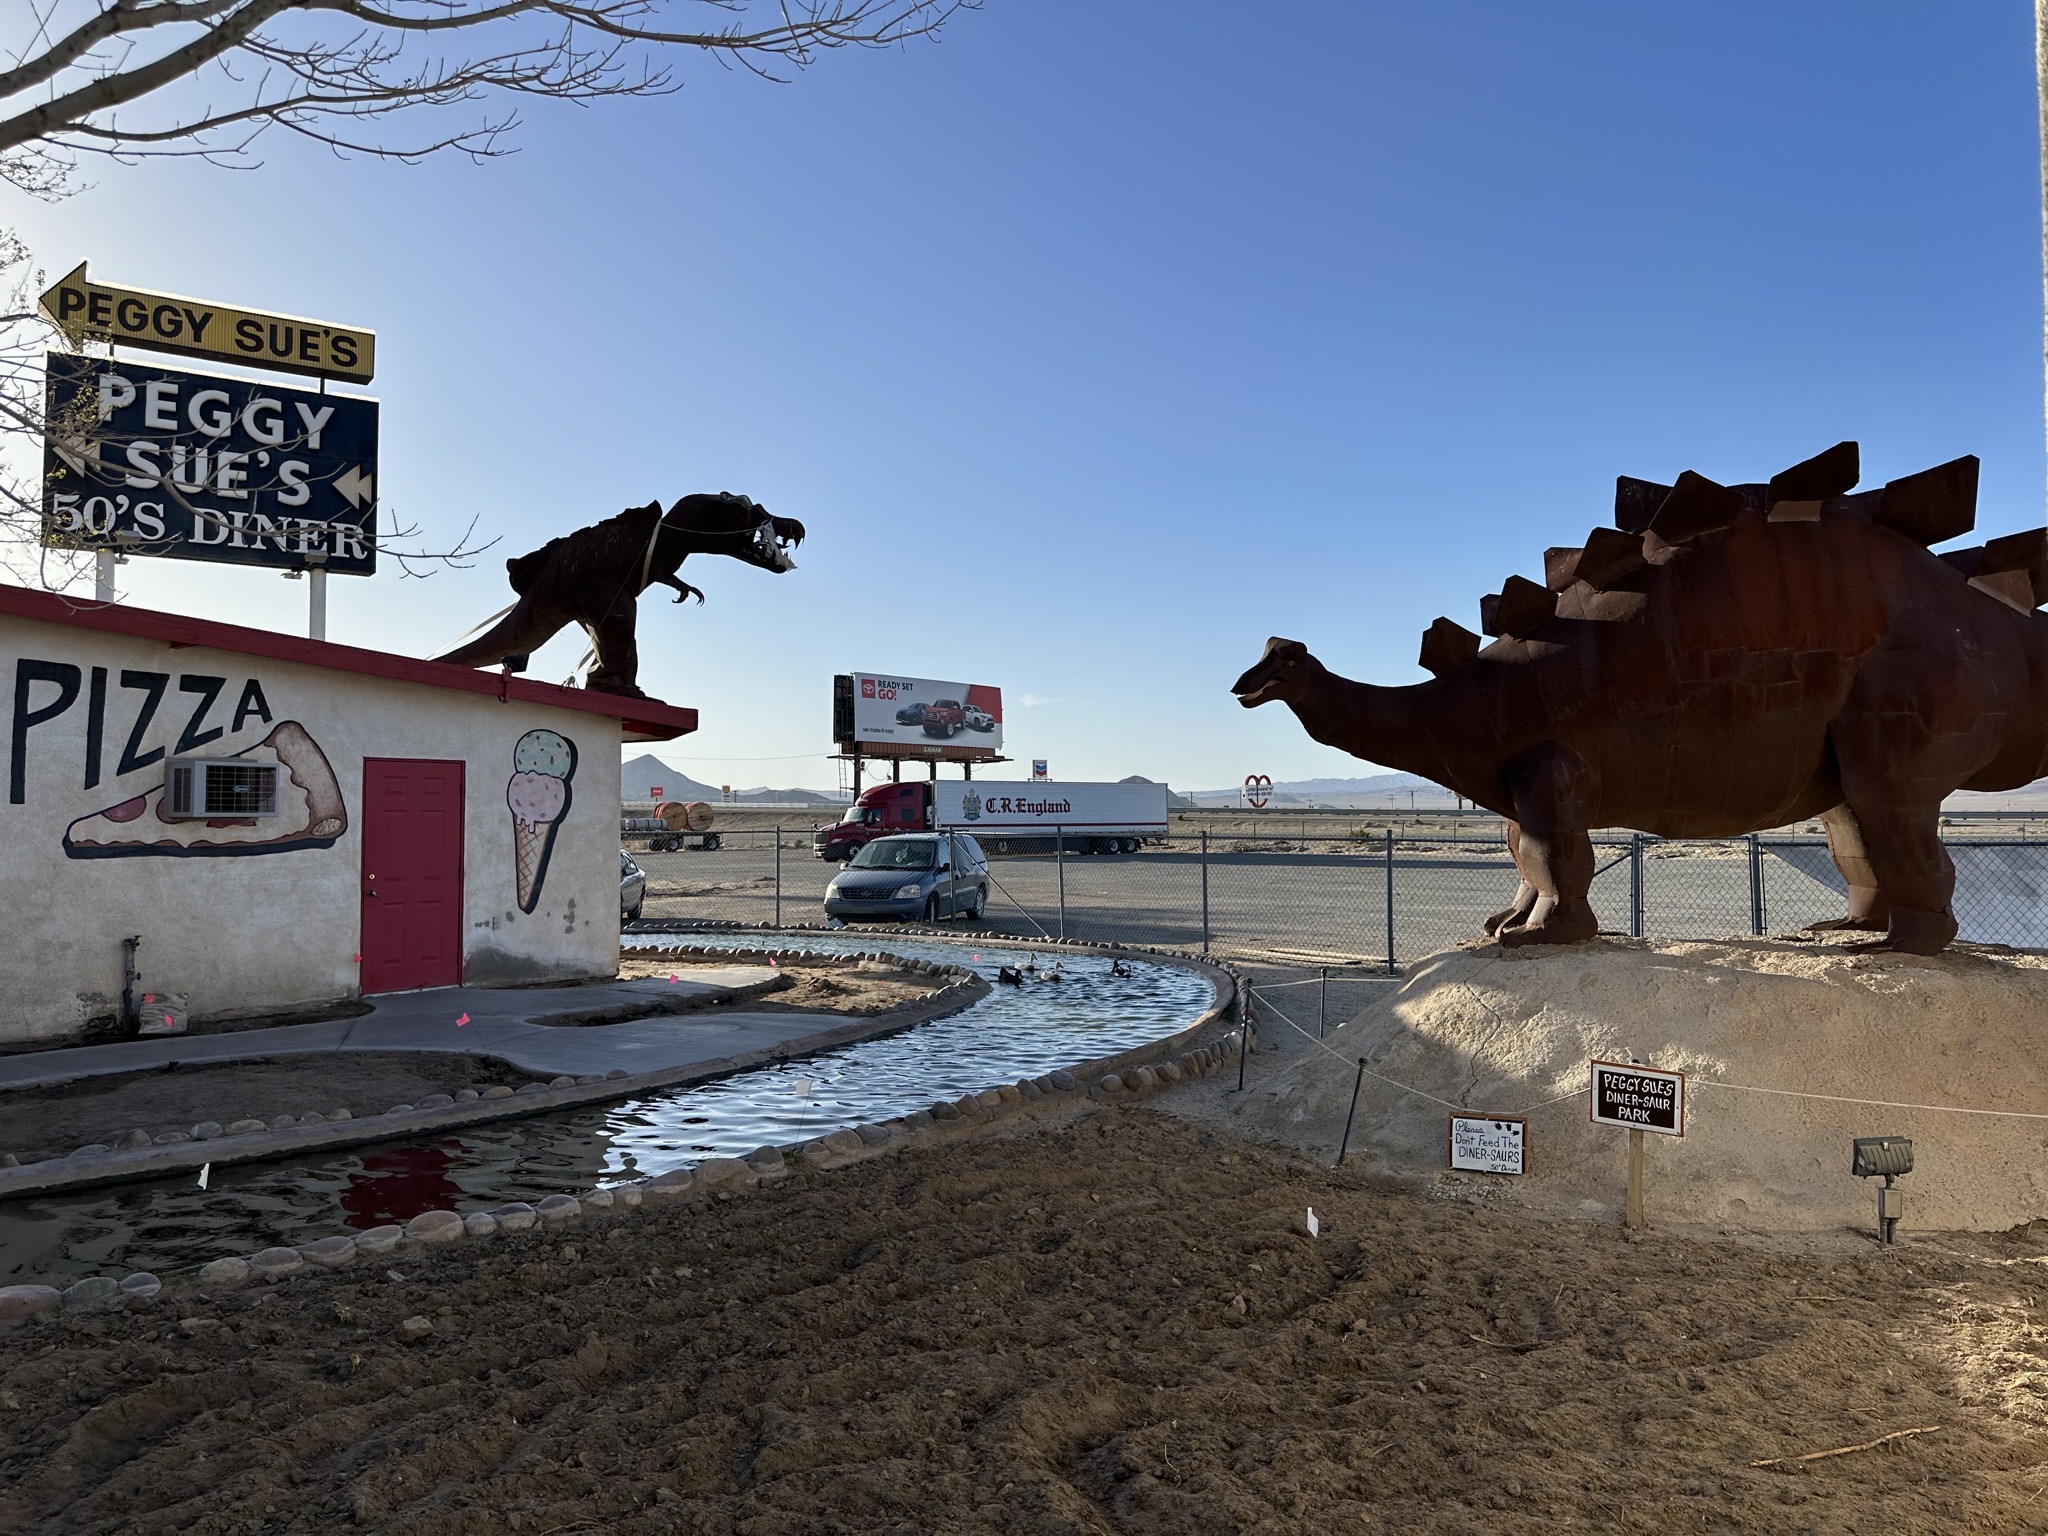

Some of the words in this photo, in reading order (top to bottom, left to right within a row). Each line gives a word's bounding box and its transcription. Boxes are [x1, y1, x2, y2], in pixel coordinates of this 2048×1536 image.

[58, 286, 214, 344] PEGGY
[233, 318, 359, 368] SUE'S
[97, 372, 336, 451] PEGGY
[124, 440, 311, 507] SUE'S
[51, 492, 167, 541] 50'S
[187, 506, 369, 561] DINER
[877, 679, 901, 690] READY
[901, 682, 914, 691] SET
[877, 688, 897, 701] GO!
[10, 658, 274, 805] PIZZA
[1603, 1073, 1641, 1092] PEGGY
[1641, 1078, 1674, 1097] SUE'S
[1618, 1106, 1651, 1123] PARK
[1455, 1120, 1486, 1134] Please
[1455, 1133, 1476, 1145] Don't
[1478, 1134, 1500, 1148] Feed
[1501, 1136, 1520, 1150] The
